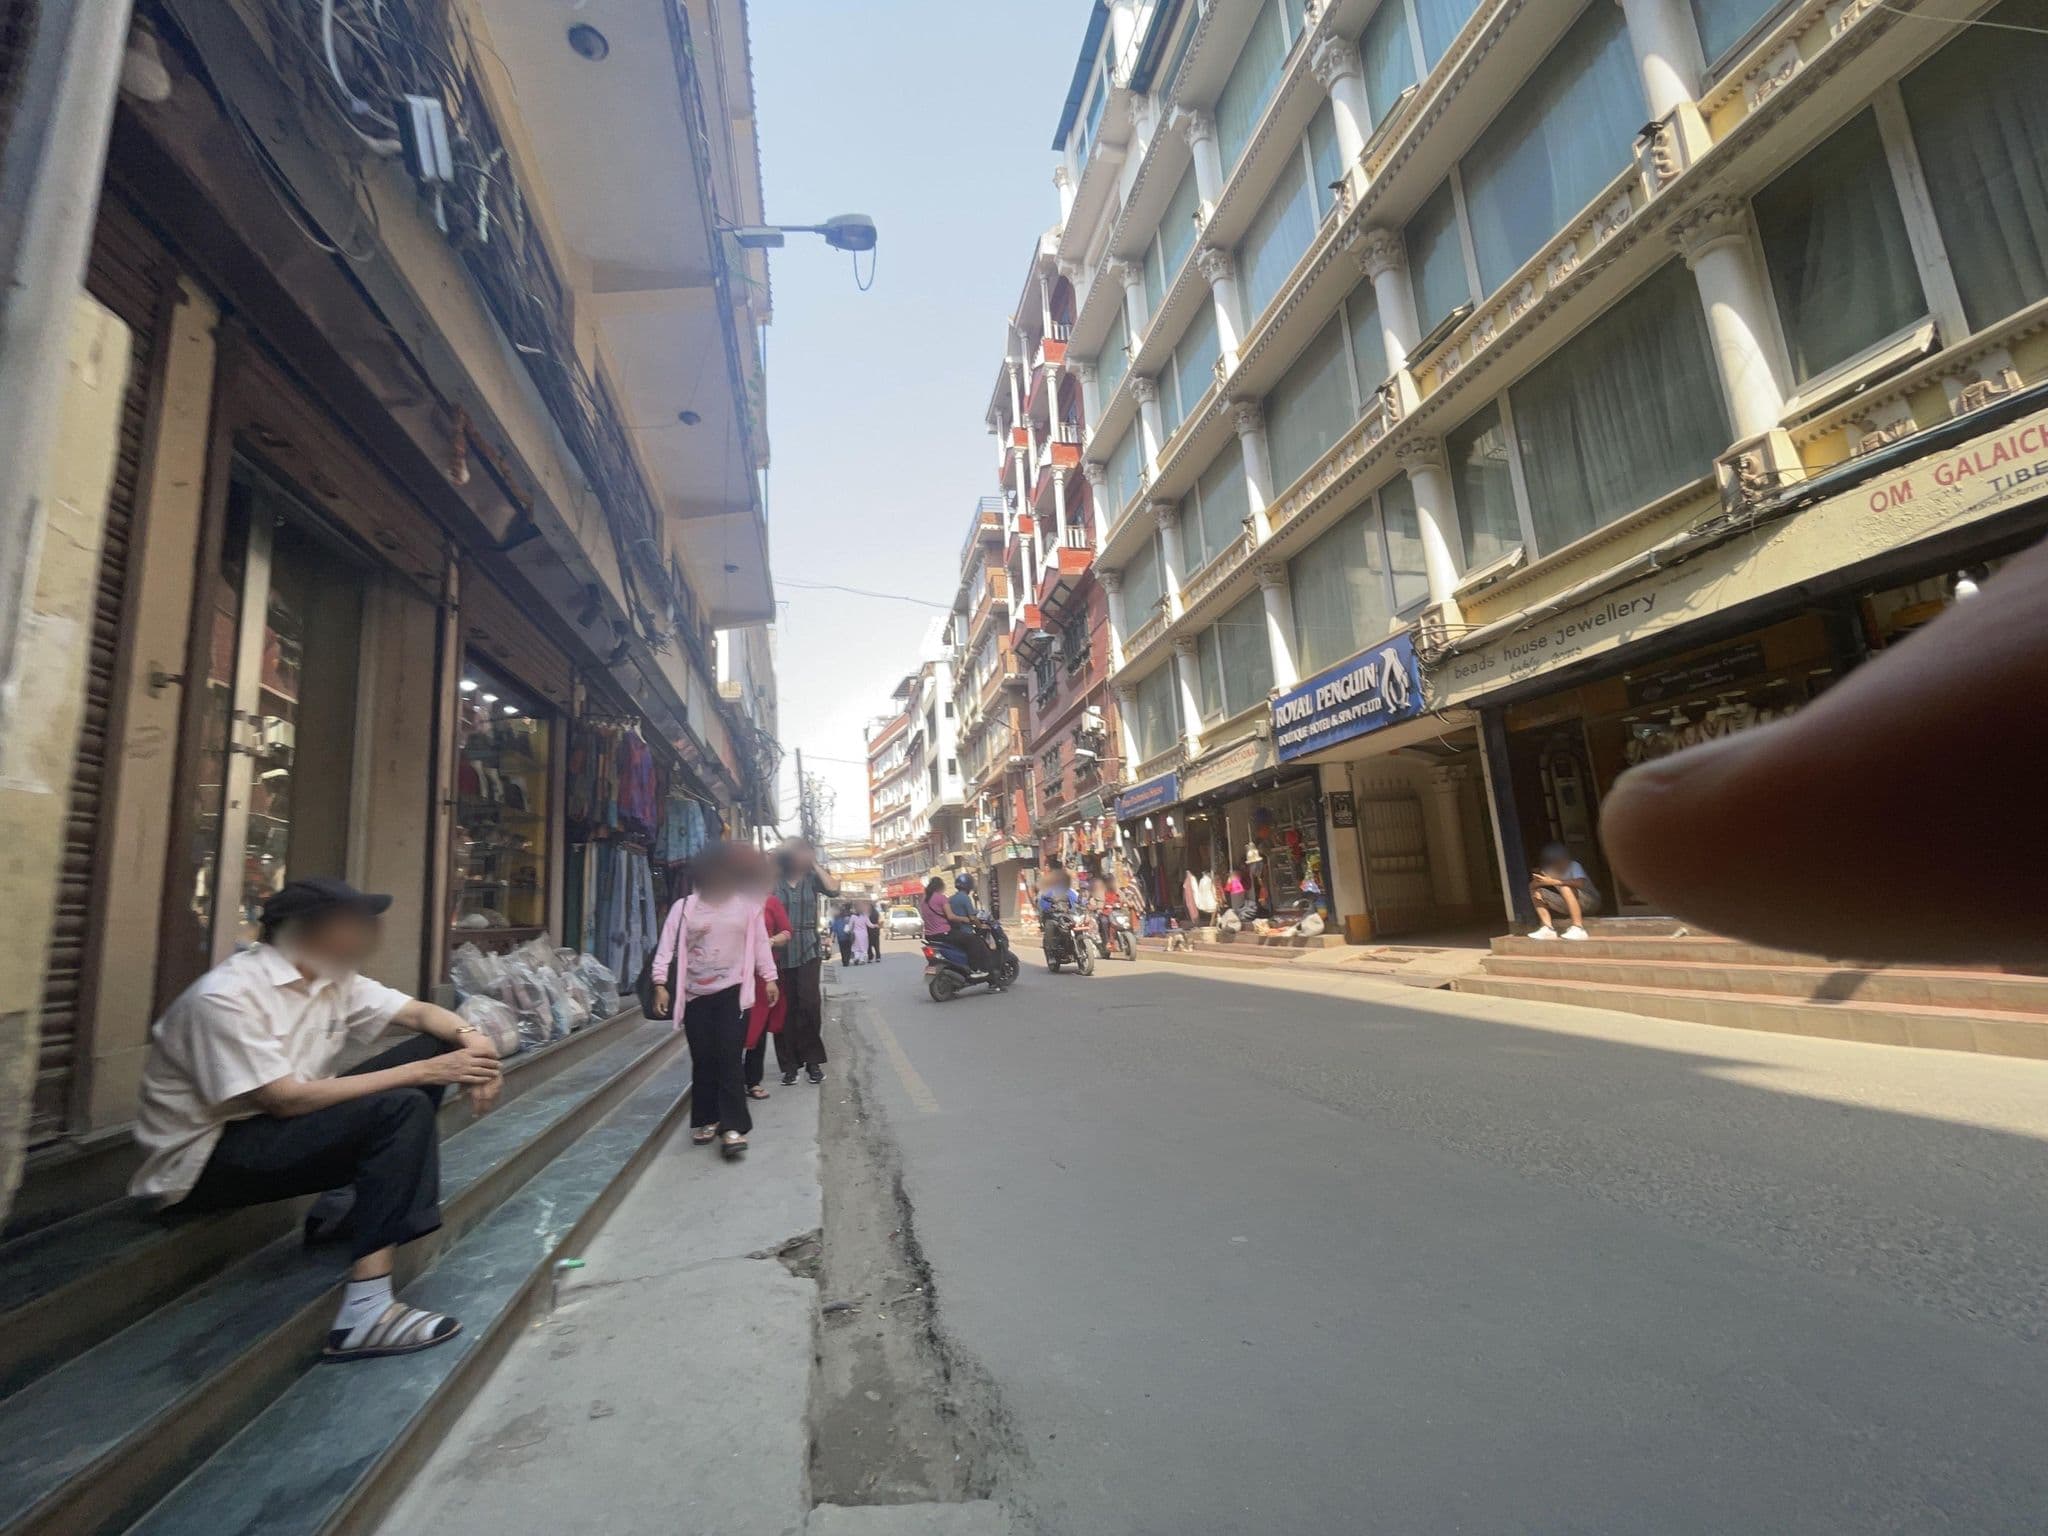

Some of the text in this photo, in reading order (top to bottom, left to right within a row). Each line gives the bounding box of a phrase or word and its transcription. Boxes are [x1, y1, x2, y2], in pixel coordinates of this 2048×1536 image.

[1869, 479, 1914, 513] OM
[1454, 655, 1497, 680] beads
[1503, 636, 1549, 661] house
[1274, 662, 1377, 729] ROYAL PENGUIN
